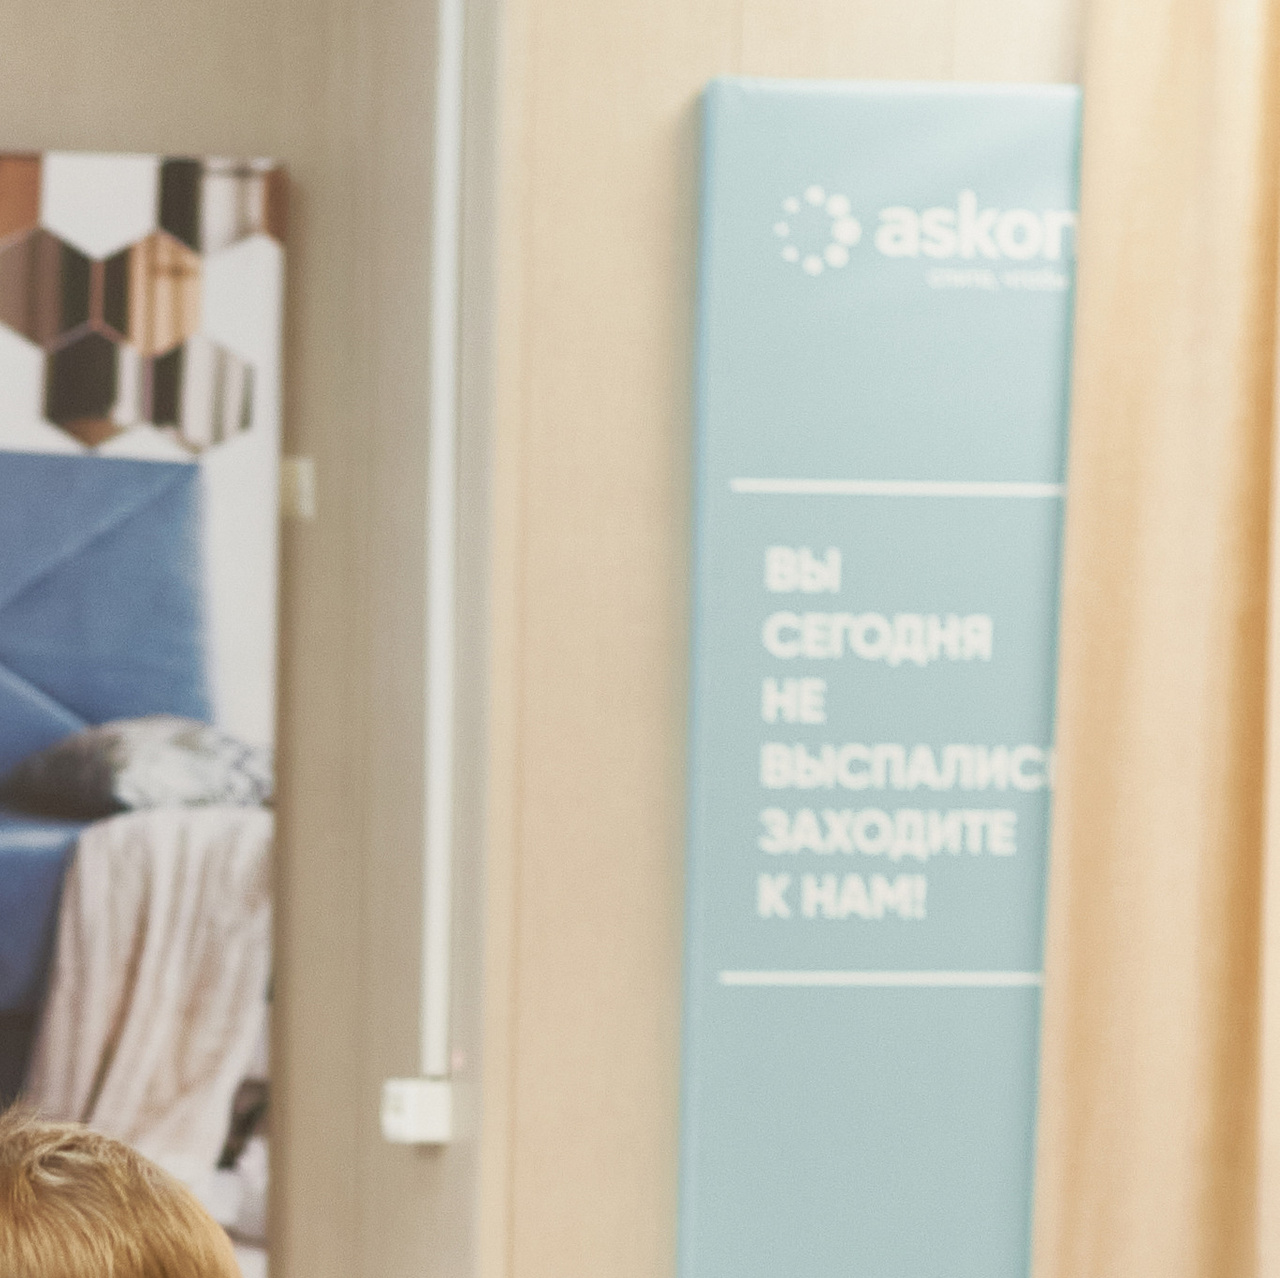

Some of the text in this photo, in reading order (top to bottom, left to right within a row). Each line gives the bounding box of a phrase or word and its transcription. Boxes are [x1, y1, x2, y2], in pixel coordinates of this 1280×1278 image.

[764, 545, 842, 594] ВЫ
[761, 610, 994, 667] СЕГОДНЯ
[760, 677, 827, 724] НЕ
[759, 743, 1057, 791] ВЫСПАЛИС
[758, 808, 1018, 861] ЗАХОДИТЕ
[756, 873, 927, 919] К НАМ!
